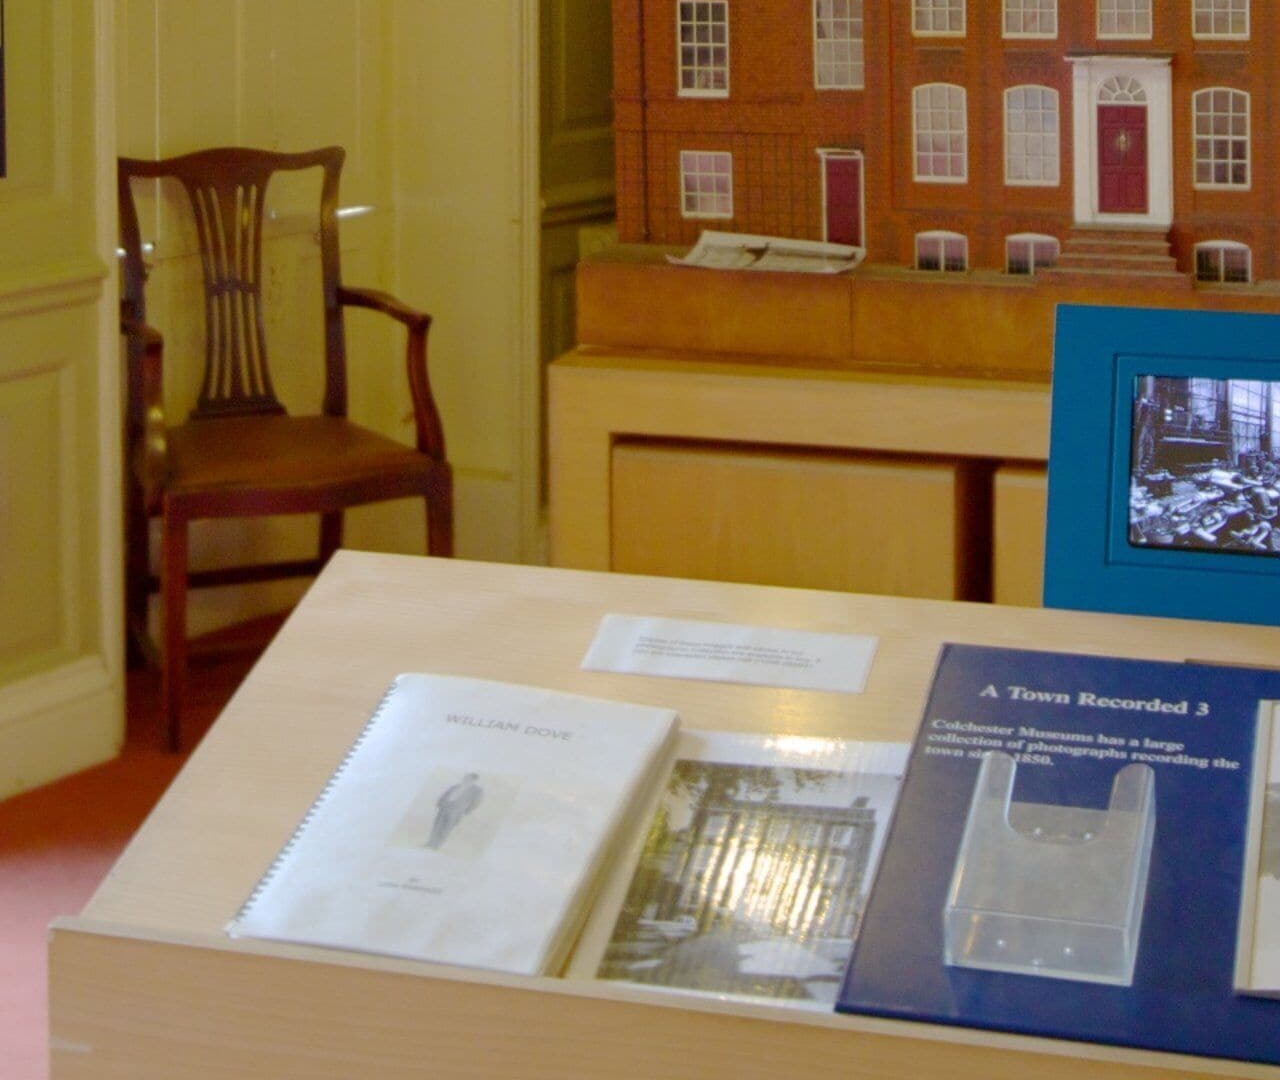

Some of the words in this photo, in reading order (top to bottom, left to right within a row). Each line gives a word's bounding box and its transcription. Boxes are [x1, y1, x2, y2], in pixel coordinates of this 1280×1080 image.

[979, 684, 999, 698] A
[1007, 685, 1070, 705] Town
[1077, 692, 1188, 715] Recorded
[1195, 701, 1210, 716] 3
[445, 713, 519, 731] WILLIAM
[524, 726, 572, 741] DOVE
[932, 719, 1014, 736] Colchester
[1019, 726, 1094, 743] Museums
[1096, 733, 1125, 746] has
[1128, 738, 1140, 747] a
[1143, 737, 1185, 752] large
[925, 745, 964, 758] town
[1015, 752, 1054, 766] 1850.
[928, 732, 1003, 748] collection
[1006, 738, 1025, 750] of
[1026, 740, 1127, 760] photographs
[1131, 751, 1210, 769] recording
[1213, 756, 1240, 770] the
